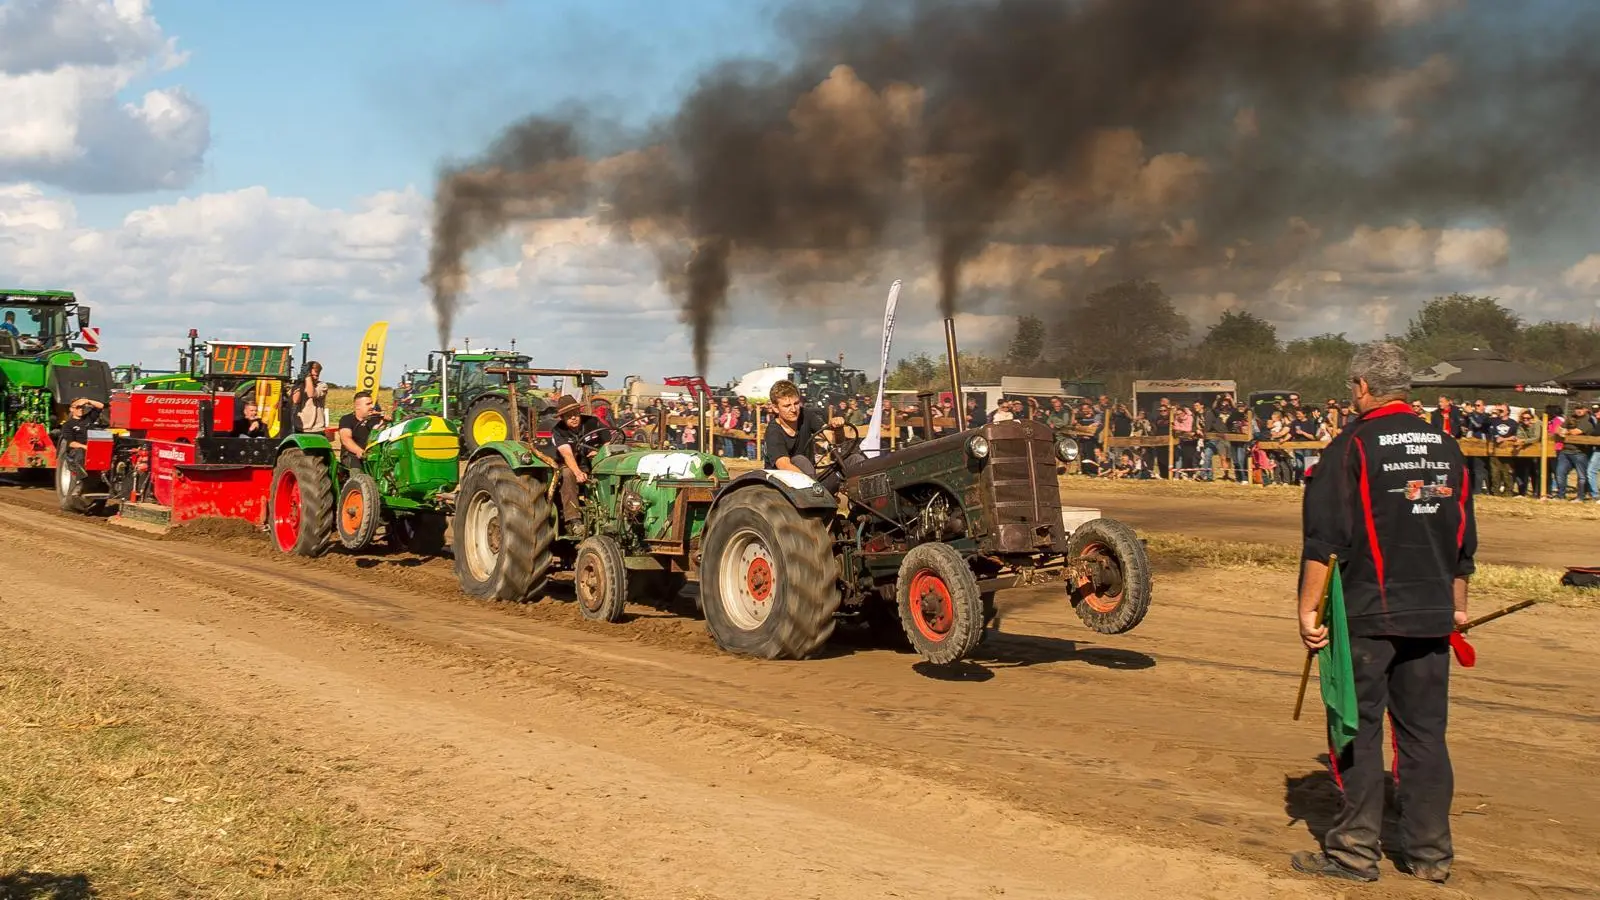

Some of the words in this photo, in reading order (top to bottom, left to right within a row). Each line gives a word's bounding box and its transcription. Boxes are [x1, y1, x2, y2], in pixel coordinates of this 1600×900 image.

[145, 396, 220, 405] Bremswan
[1378, 432, 1442, 445] BREMSWAGEN
[1405, 445, 1428, 455] TEAM
